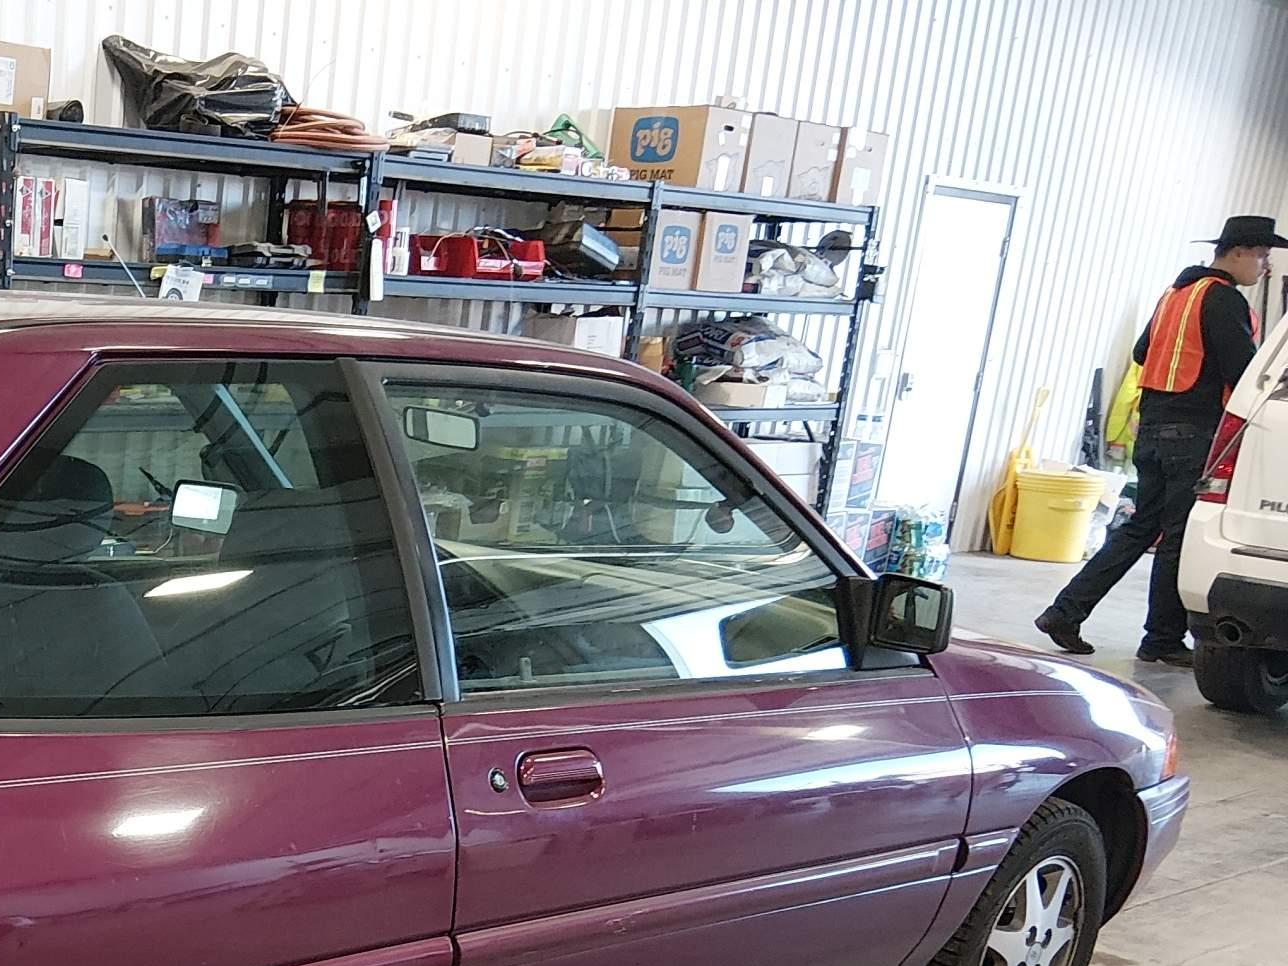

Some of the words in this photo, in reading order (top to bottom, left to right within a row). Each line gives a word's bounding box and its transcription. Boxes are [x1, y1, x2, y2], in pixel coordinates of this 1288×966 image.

[635, 121, 674, 156] pig
[630, 168, 649, 180] PIG
[651, 168, 675, 180] MAT
[1259, 499, 1288, 513] PIL
